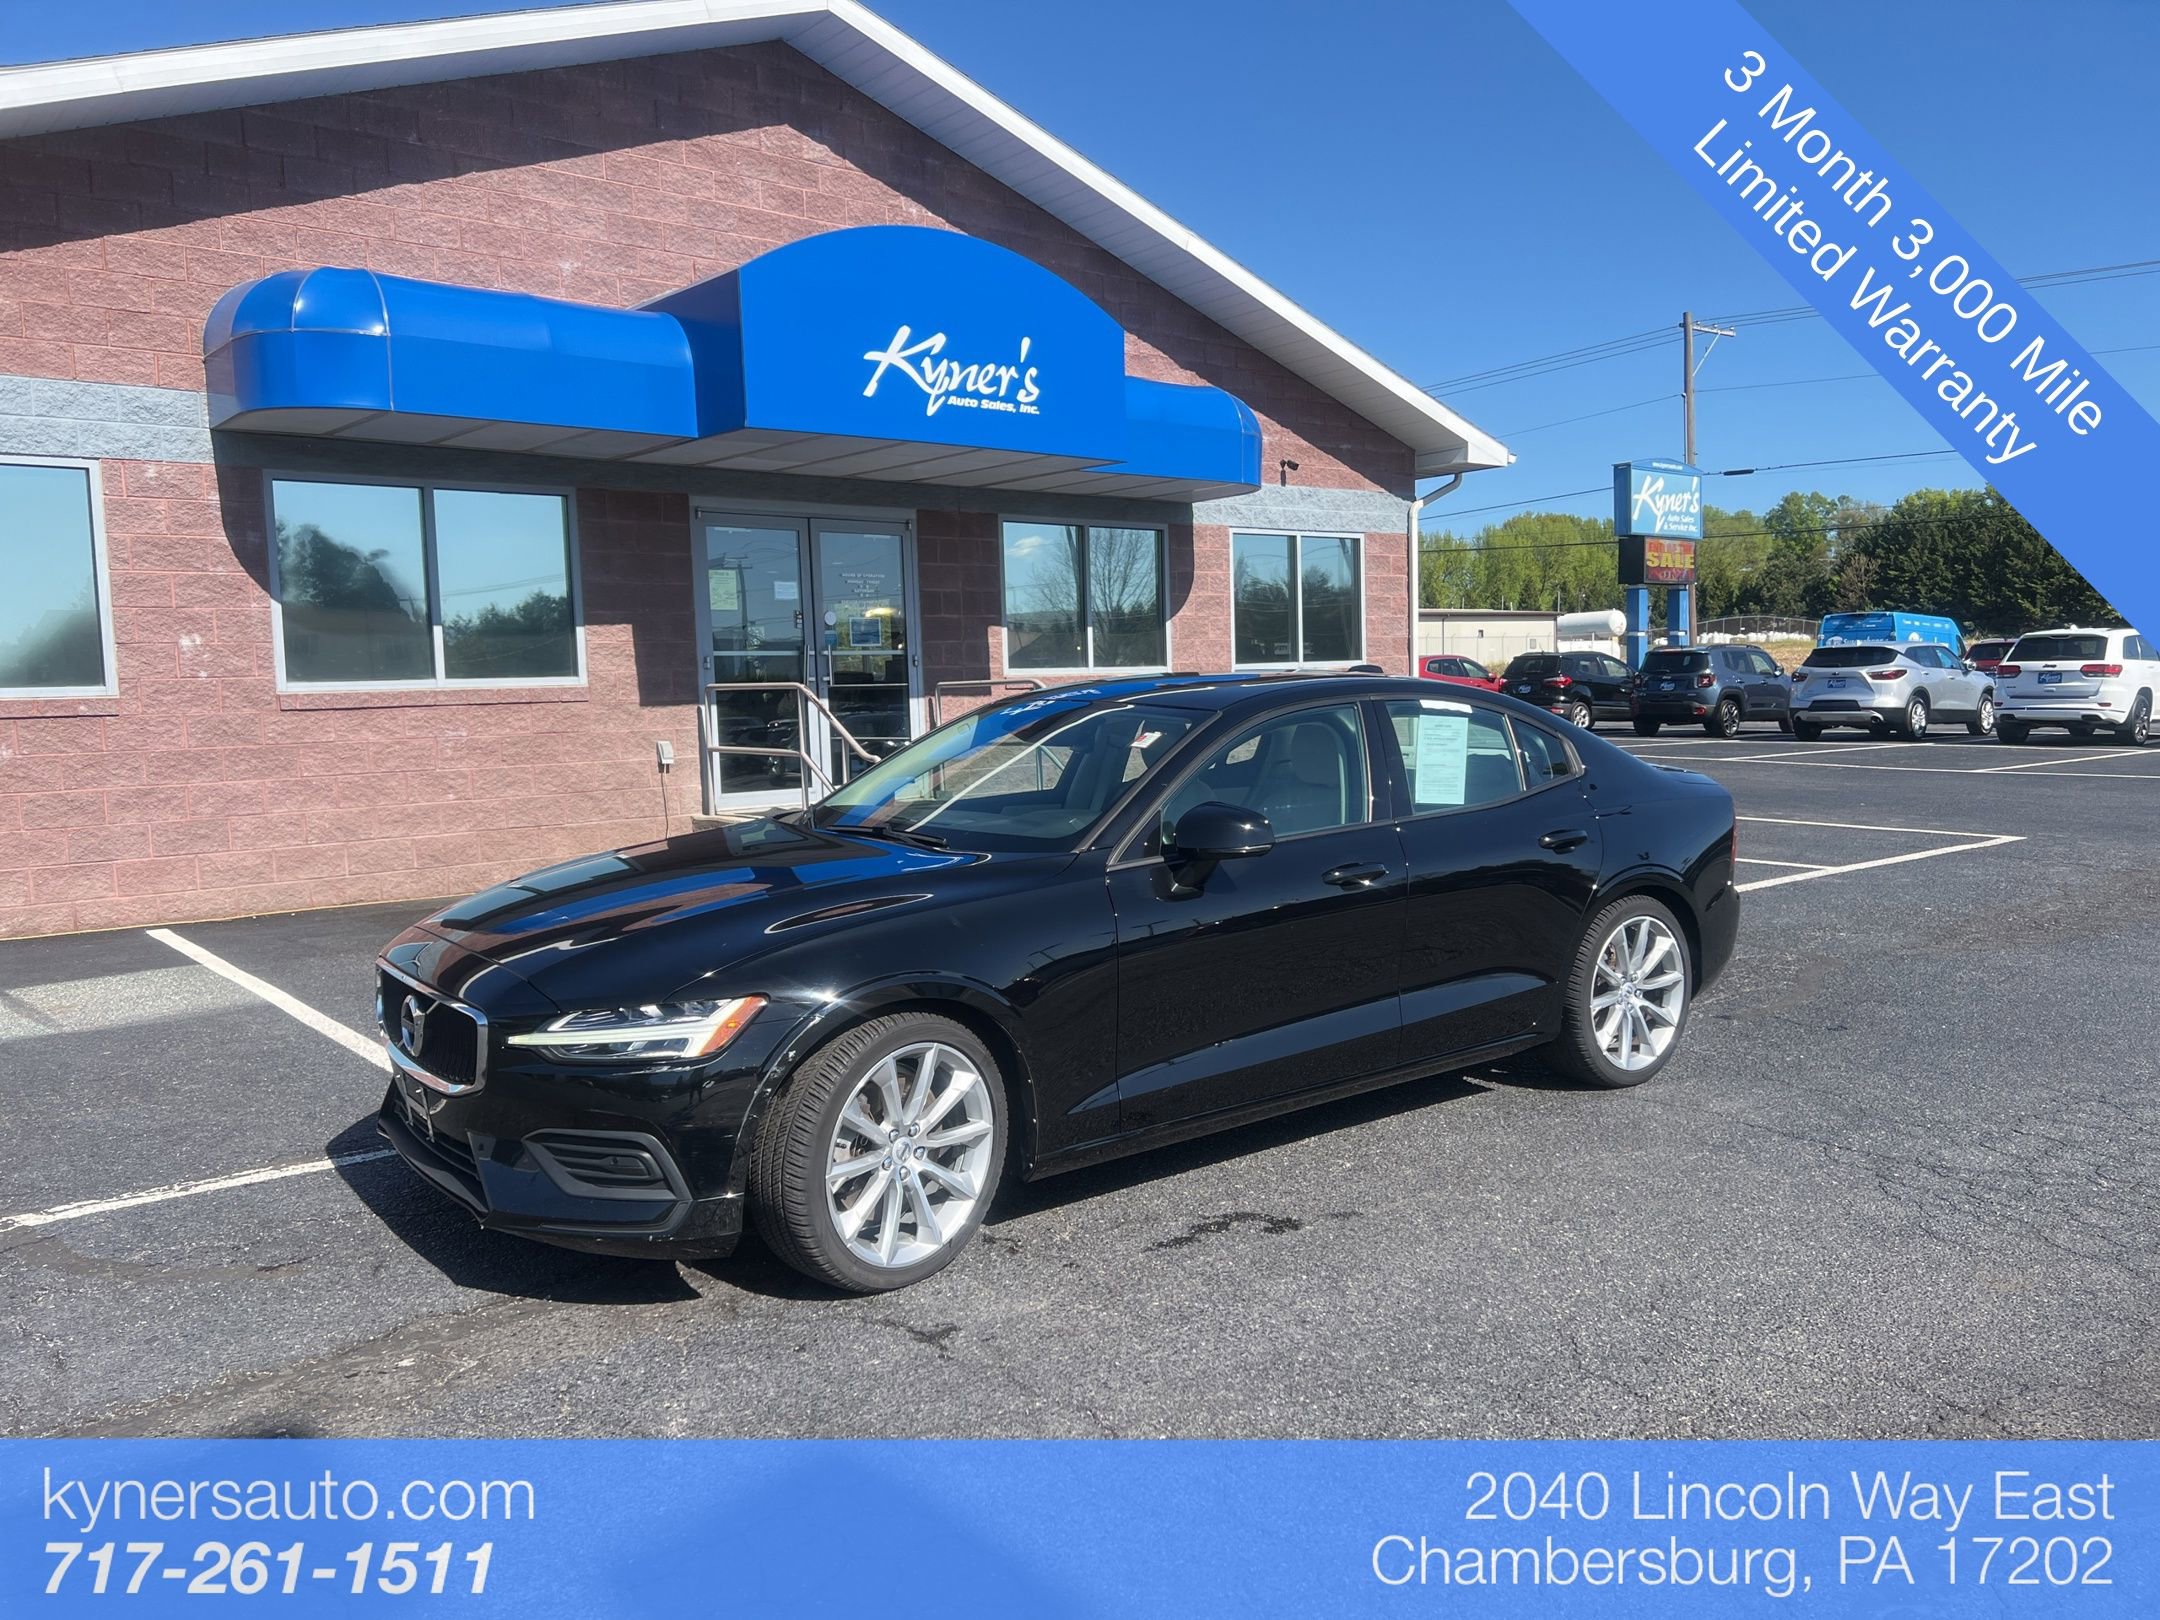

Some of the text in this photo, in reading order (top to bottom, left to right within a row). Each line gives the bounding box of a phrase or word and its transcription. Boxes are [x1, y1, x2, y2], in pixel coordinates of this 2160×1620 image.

[863, 325, 1040, 416] Kyner's
[947, 396, 1040, 415] Auto Sales, Inc.
[1632, 475, 1700, 533] Kyner's
[1667, 513, 1695, 524] Auto Sales
[1669, 522, 1688, 532] Service
[1646, 551, 1695, 569] SALE
